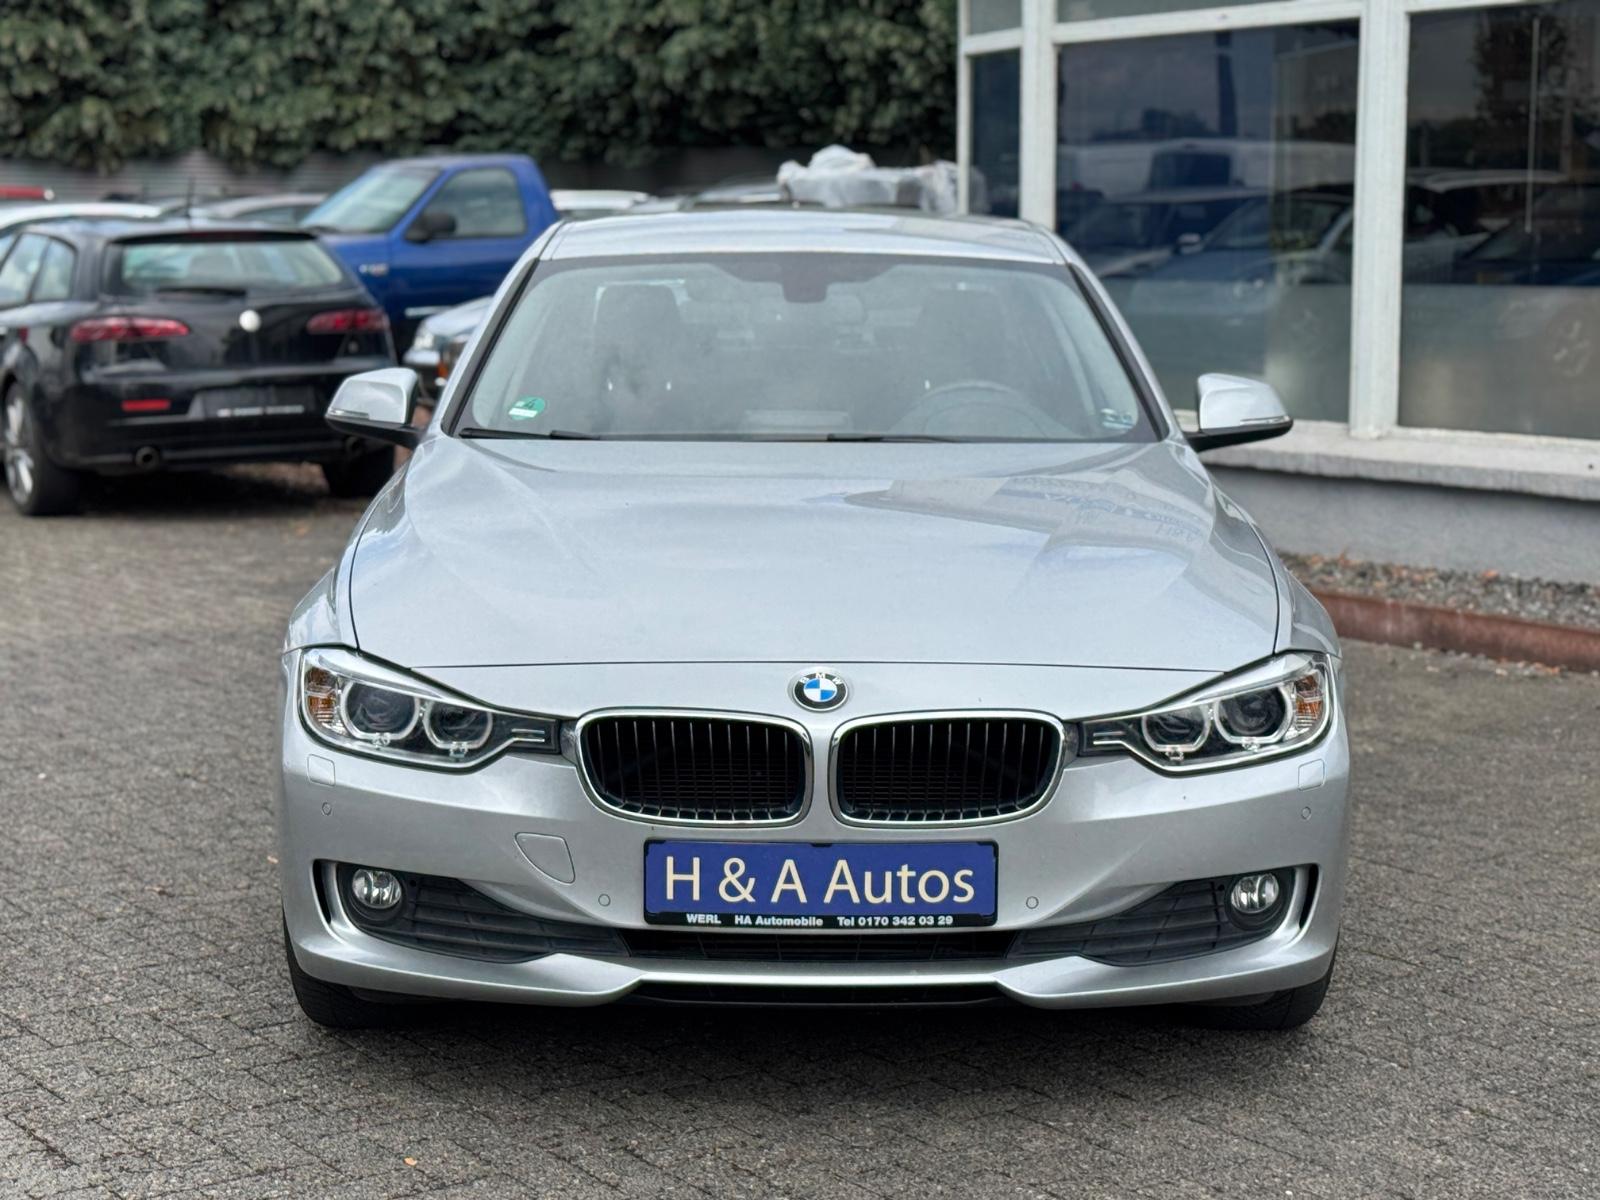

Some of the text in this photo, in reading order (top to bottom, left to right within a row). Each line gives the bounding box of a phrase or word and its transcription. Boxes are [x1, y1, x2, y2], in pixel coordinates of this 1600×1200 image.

[798, 672, 844, 685] BMW
[666, 855, 975, 904] H & A Autos
[686, 913, 954, 927] WERL HA Automobile Tel 0170 342 03 29
